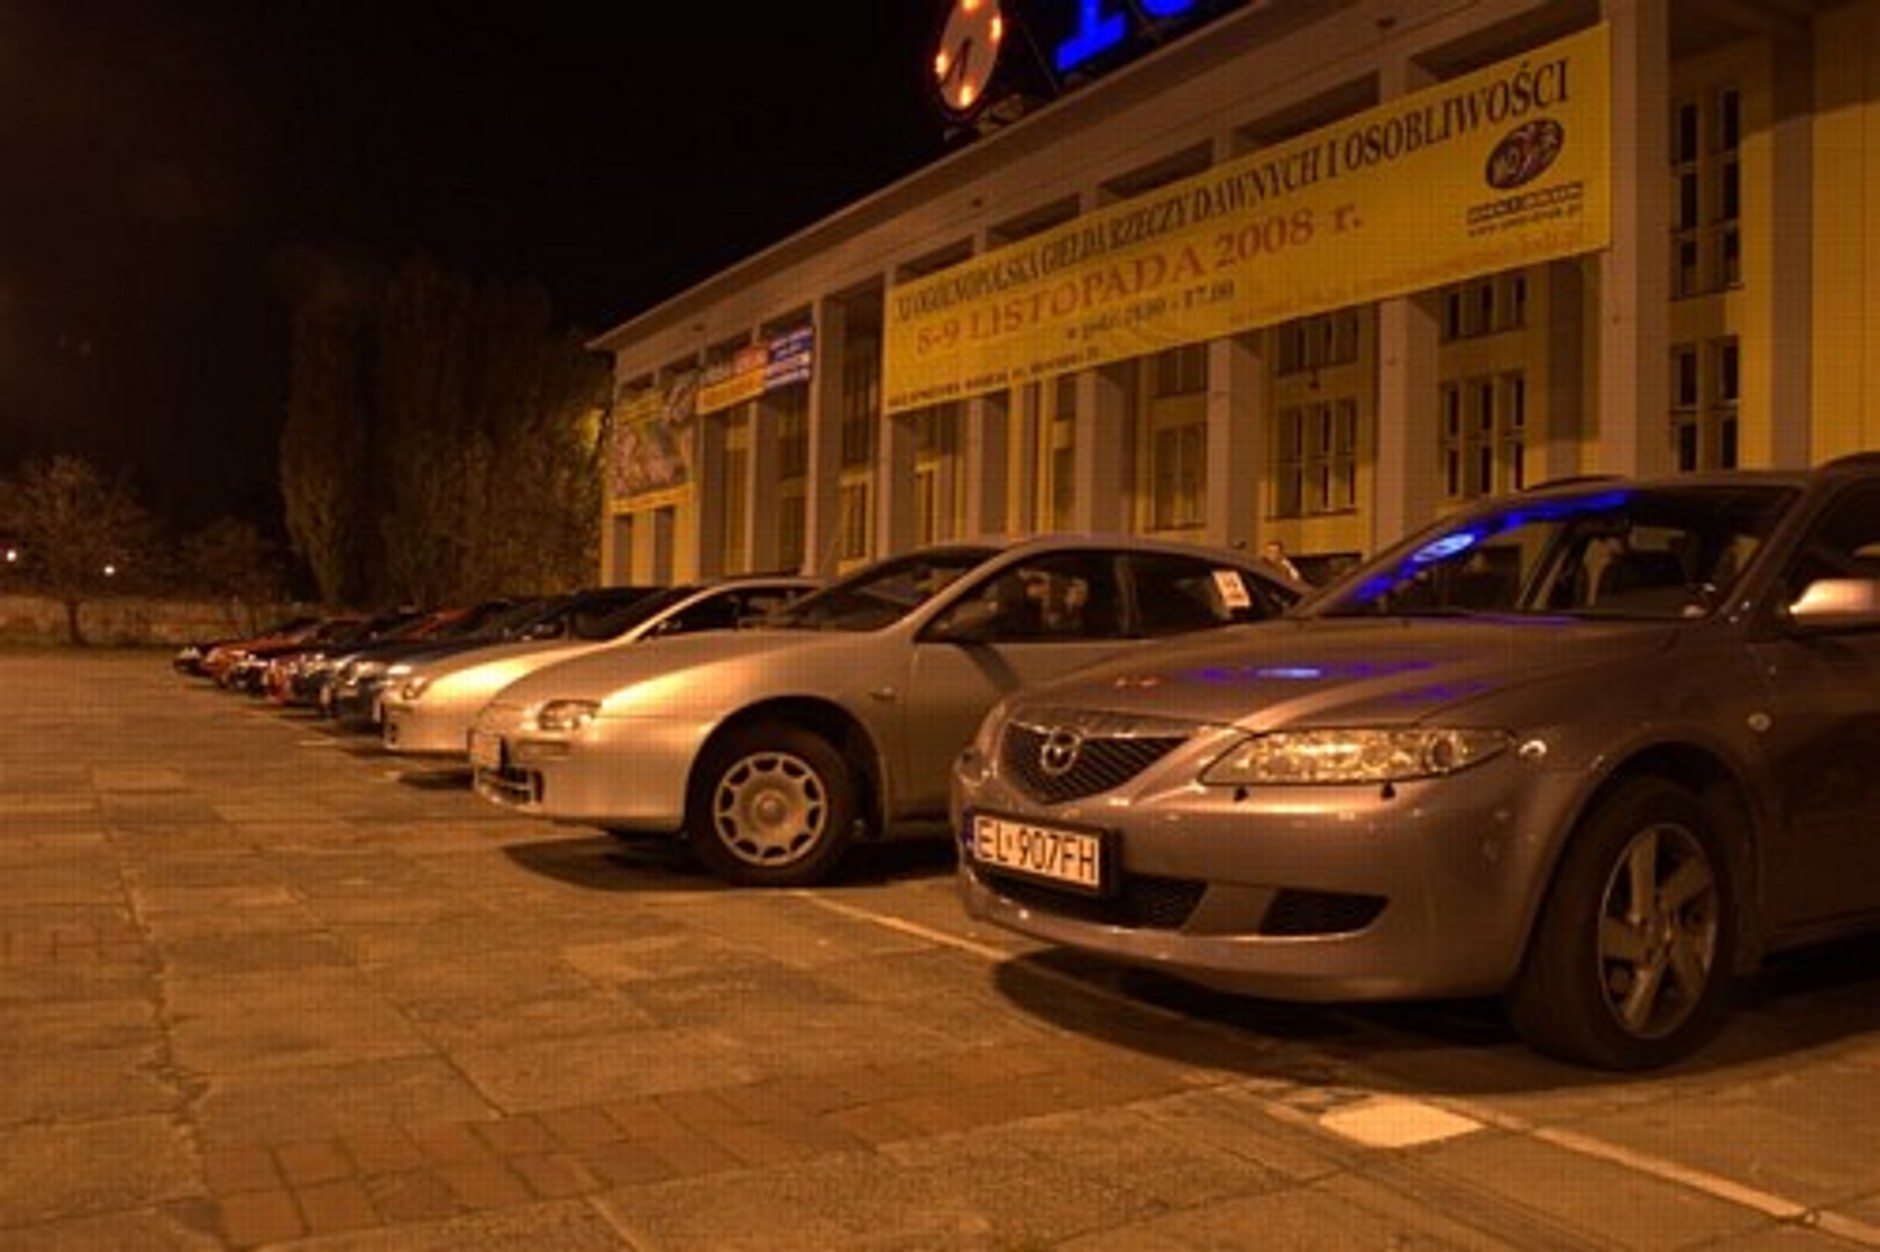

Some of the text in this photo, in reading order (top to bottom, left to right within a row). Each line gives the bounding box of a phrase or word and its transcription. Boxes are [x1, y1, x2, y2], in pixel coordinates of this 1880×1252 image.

[1191, 146, 1319, 224] DAWNYCH
[1326, 139, 1337, 178] I
[1345, 58, 1570, 172] OSOBLIWOŚCI
[969, 243, 1206, 341] LISTOPADA
[1214, 206, 1316, 272] 2008
[977, 818, 1097, 882] EL 907FH
